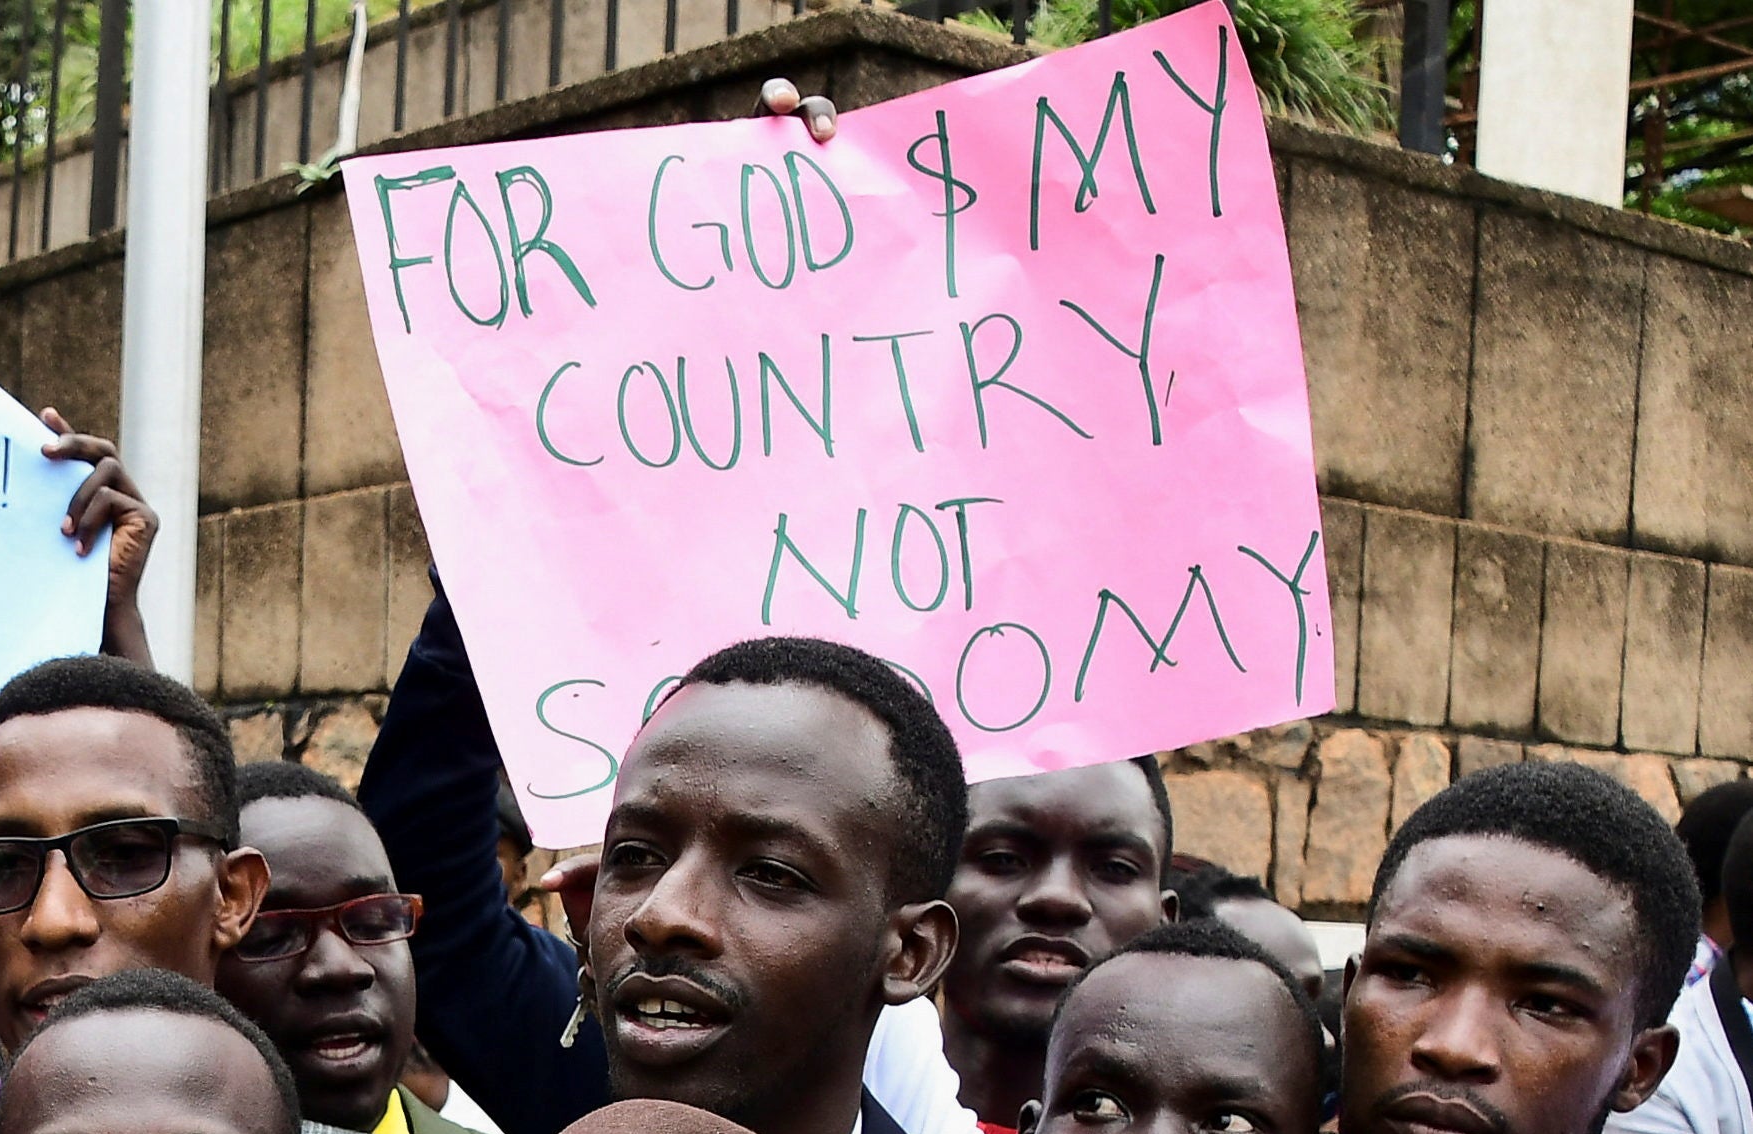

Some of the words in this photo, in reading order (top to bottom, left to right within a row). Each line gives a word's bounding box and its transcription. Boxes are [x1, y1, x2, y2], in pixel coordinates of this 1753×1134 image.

[374, 165, 597, 333] FOR
[645, 151, 854, 290] GOD
[1028, 24, 1229, 251] MY
[527, 530, 1320, 799] SOMY
[761, 496, 1003, 625] NOT
